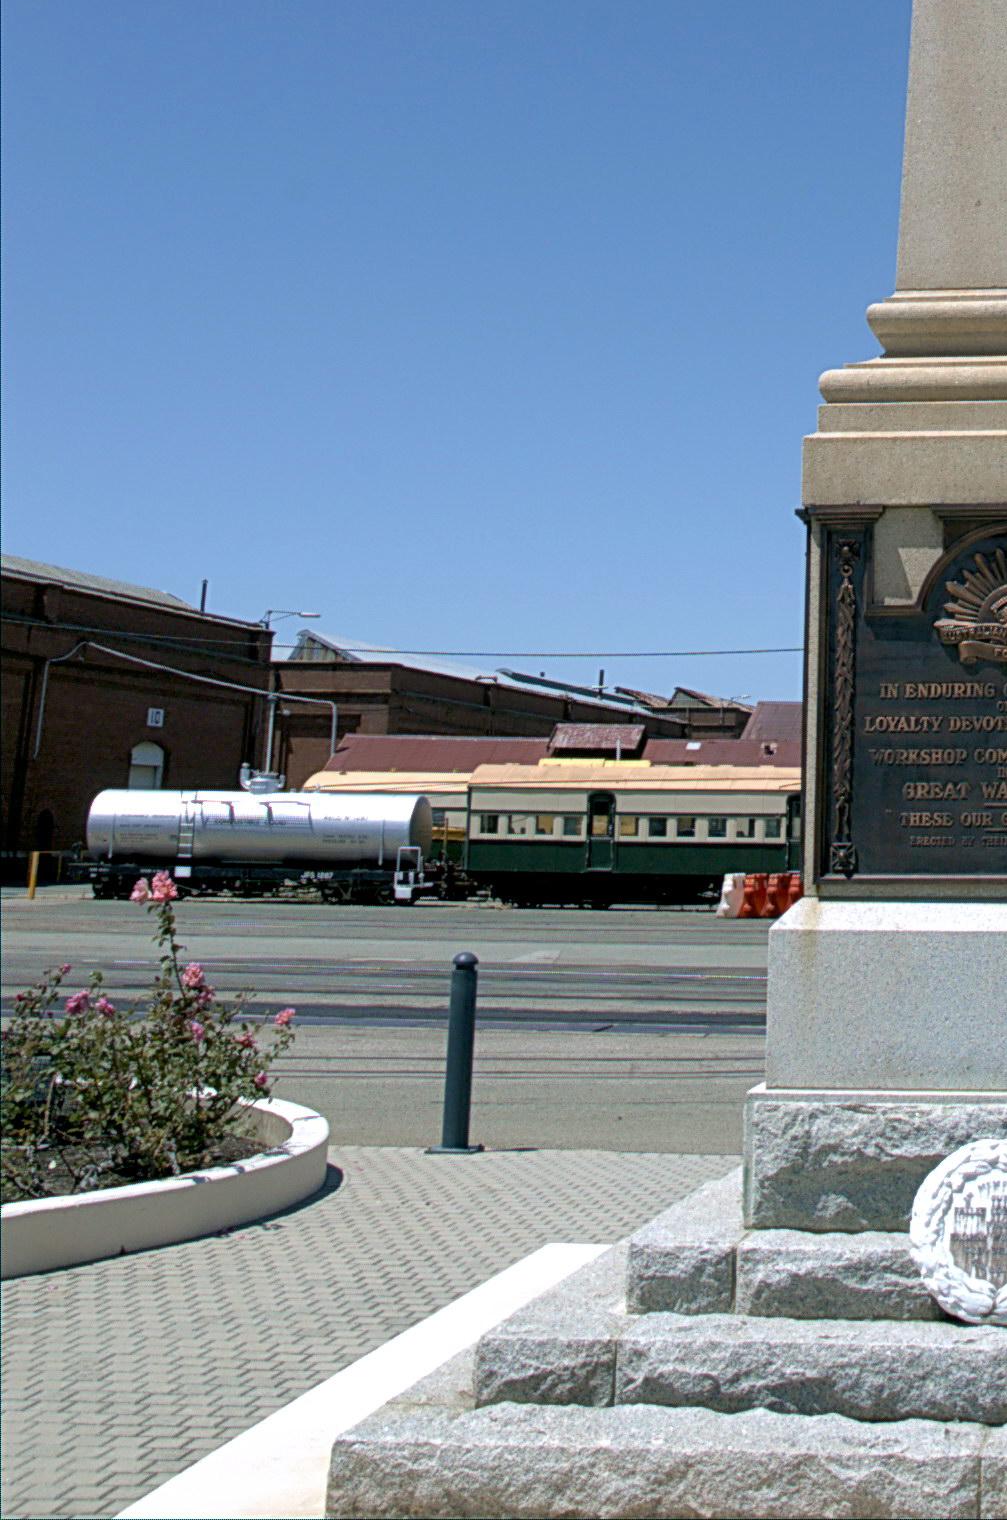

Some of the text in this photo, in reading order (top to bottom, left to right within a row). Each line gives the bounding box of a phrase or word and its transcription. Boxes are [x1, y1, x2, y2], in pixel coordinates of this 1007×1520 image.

[879, 682, 898, 699] IN
[903, 682, 996, 699] ENDURING
[864, 716, 943, 733] LOYALTY
[869, 748, 968, 765] WORKSHOP
[903, 782, 970, 800] GREAT
[959, 811, 994, 827] OUR
